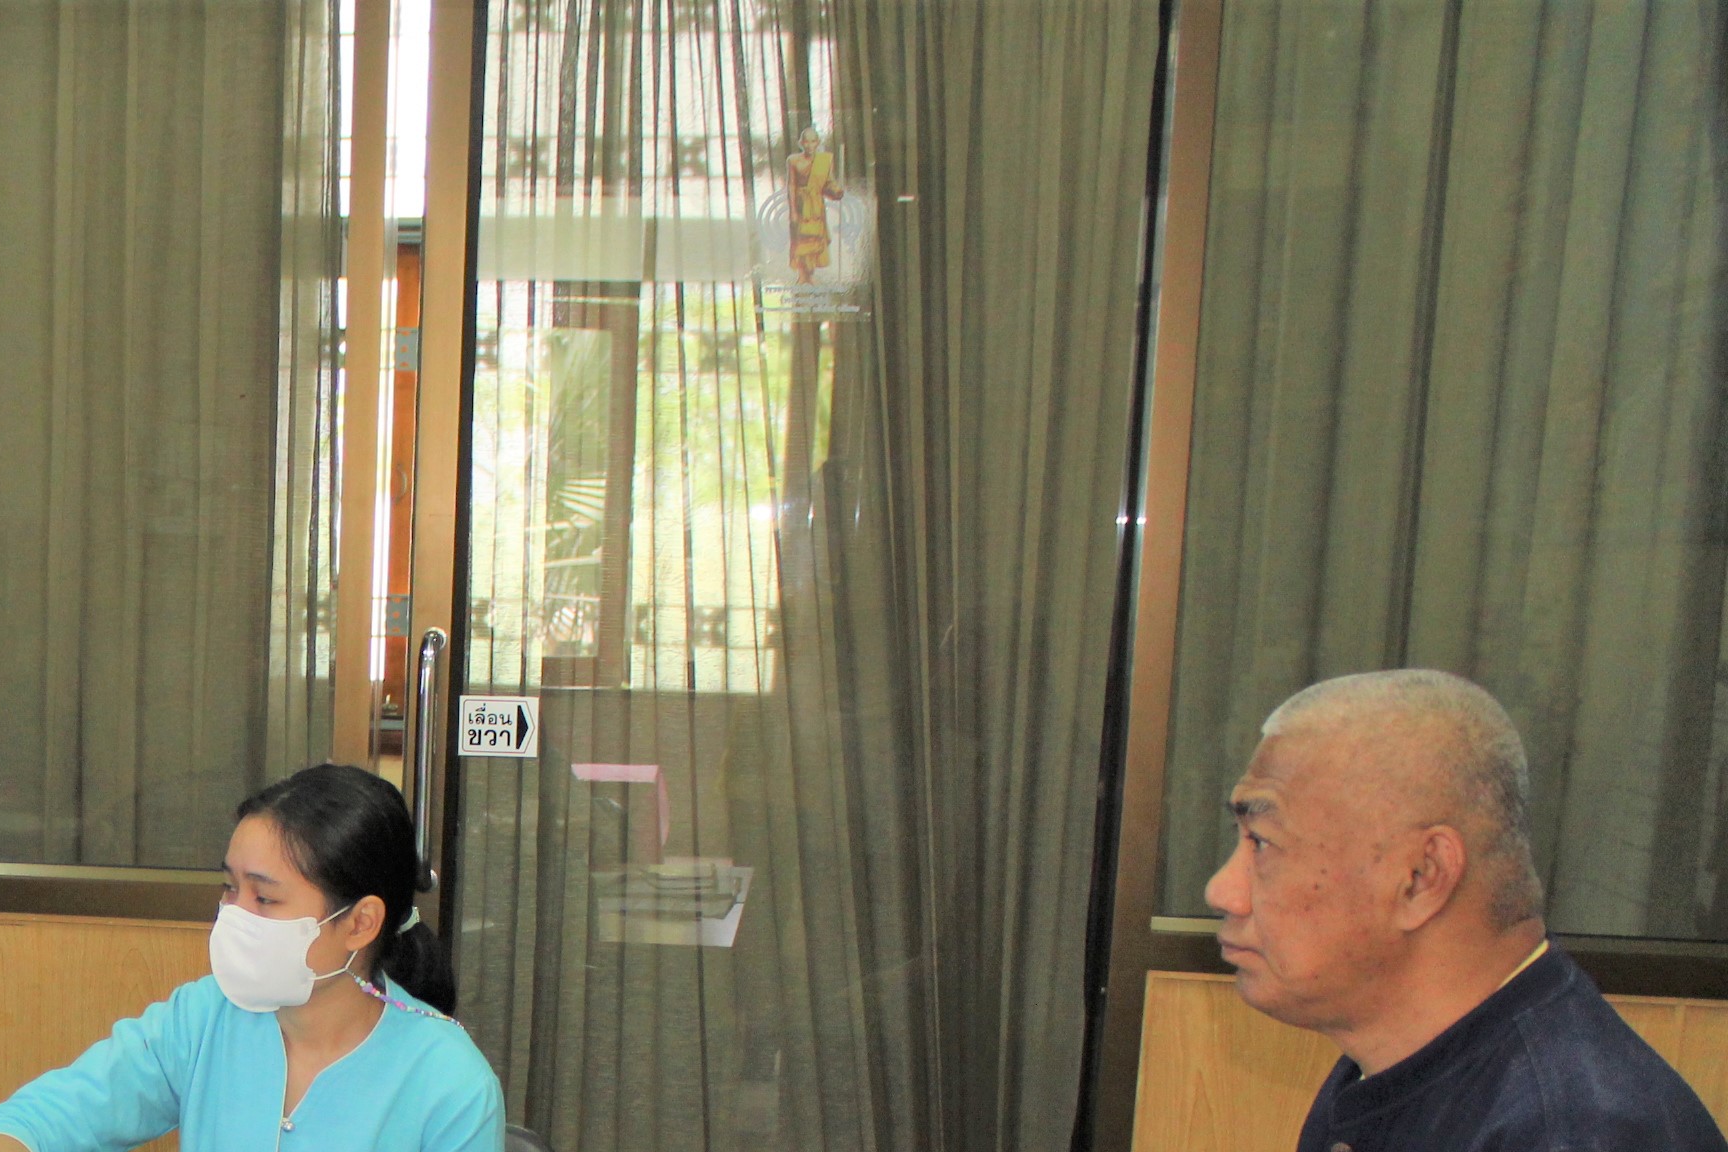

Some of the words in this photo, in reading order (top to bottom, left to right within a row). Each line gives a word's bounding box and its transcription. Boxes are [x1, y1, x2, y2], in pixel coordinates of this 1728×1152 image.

[468, 703, 513, 726] เลื่อน
[468, 728, 512, 747] ขวา
